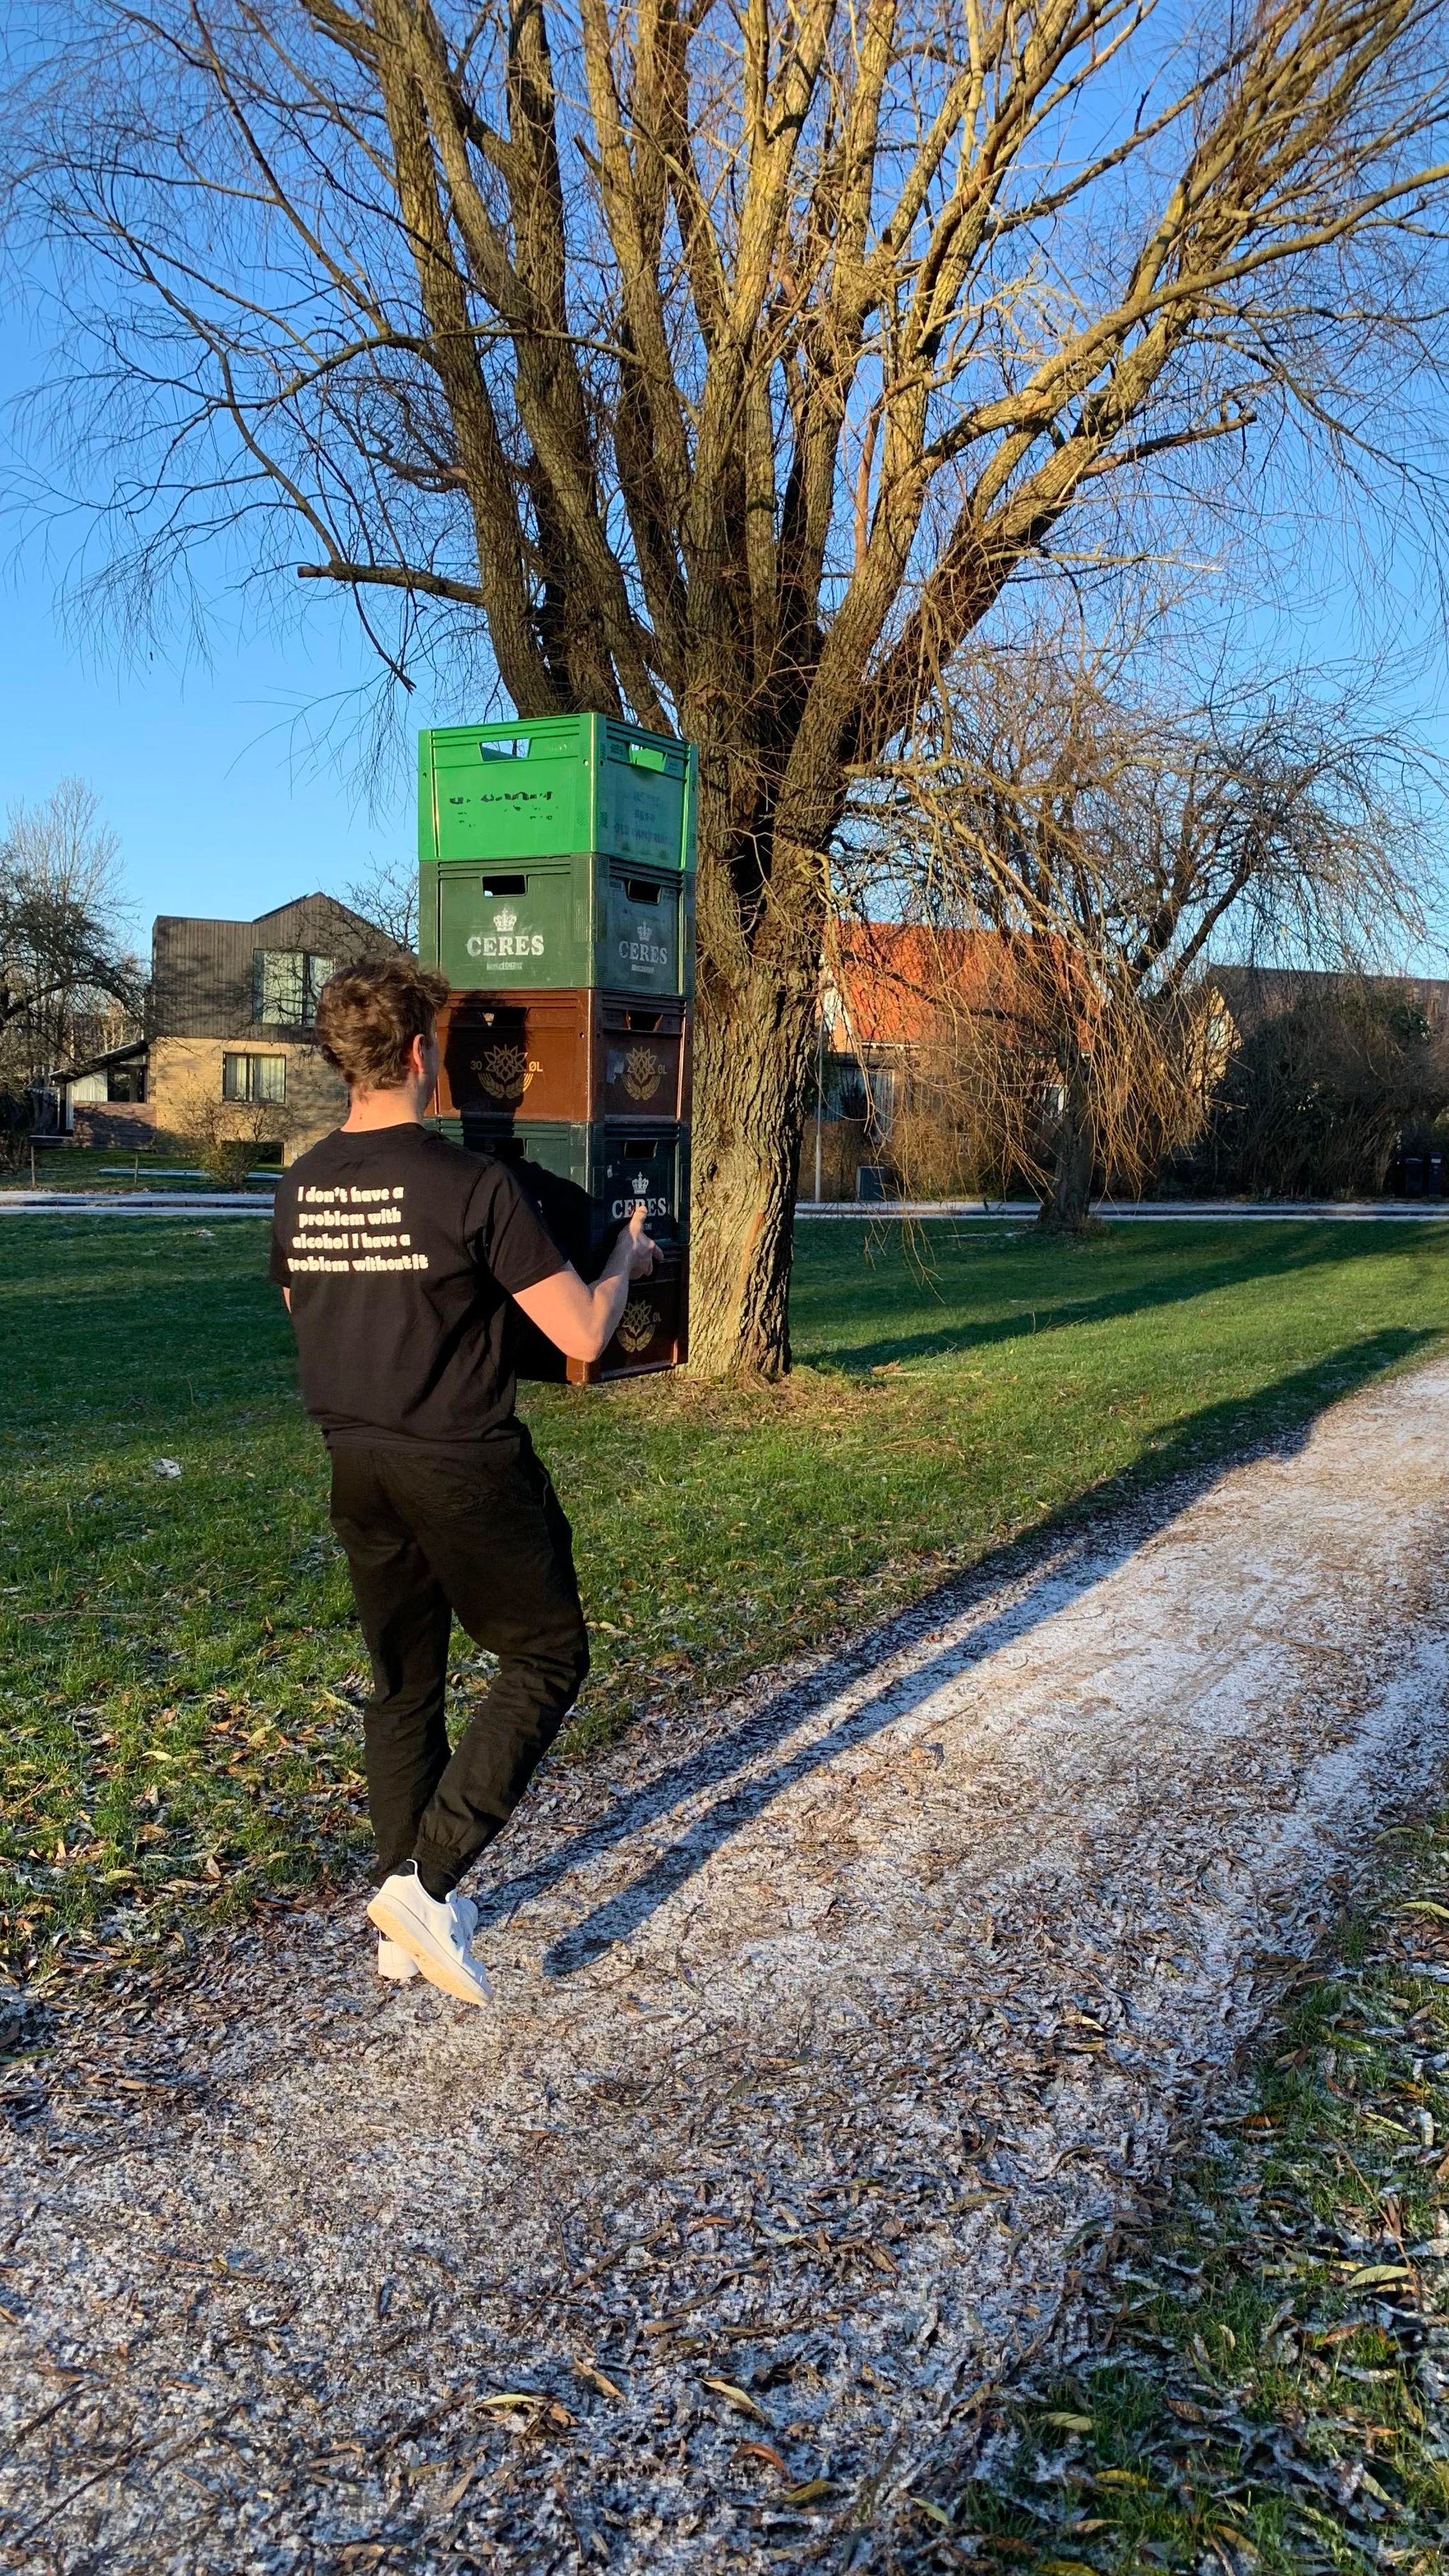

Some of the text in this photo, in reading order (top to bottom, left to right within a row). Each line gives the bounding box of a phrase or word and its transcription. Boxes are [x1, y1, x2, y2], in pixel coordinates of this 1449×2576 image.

[467, 935, 545, 957] CERES
[618, 940, 668, 965] CERES
[471, 1061, 543, 1072] 30 ØL
[298, 1186, 404, 1203] I don't have a
[299, 1207, 401, 1228] problem with
[292, 1232, 410, 1249] alcohol I have a
